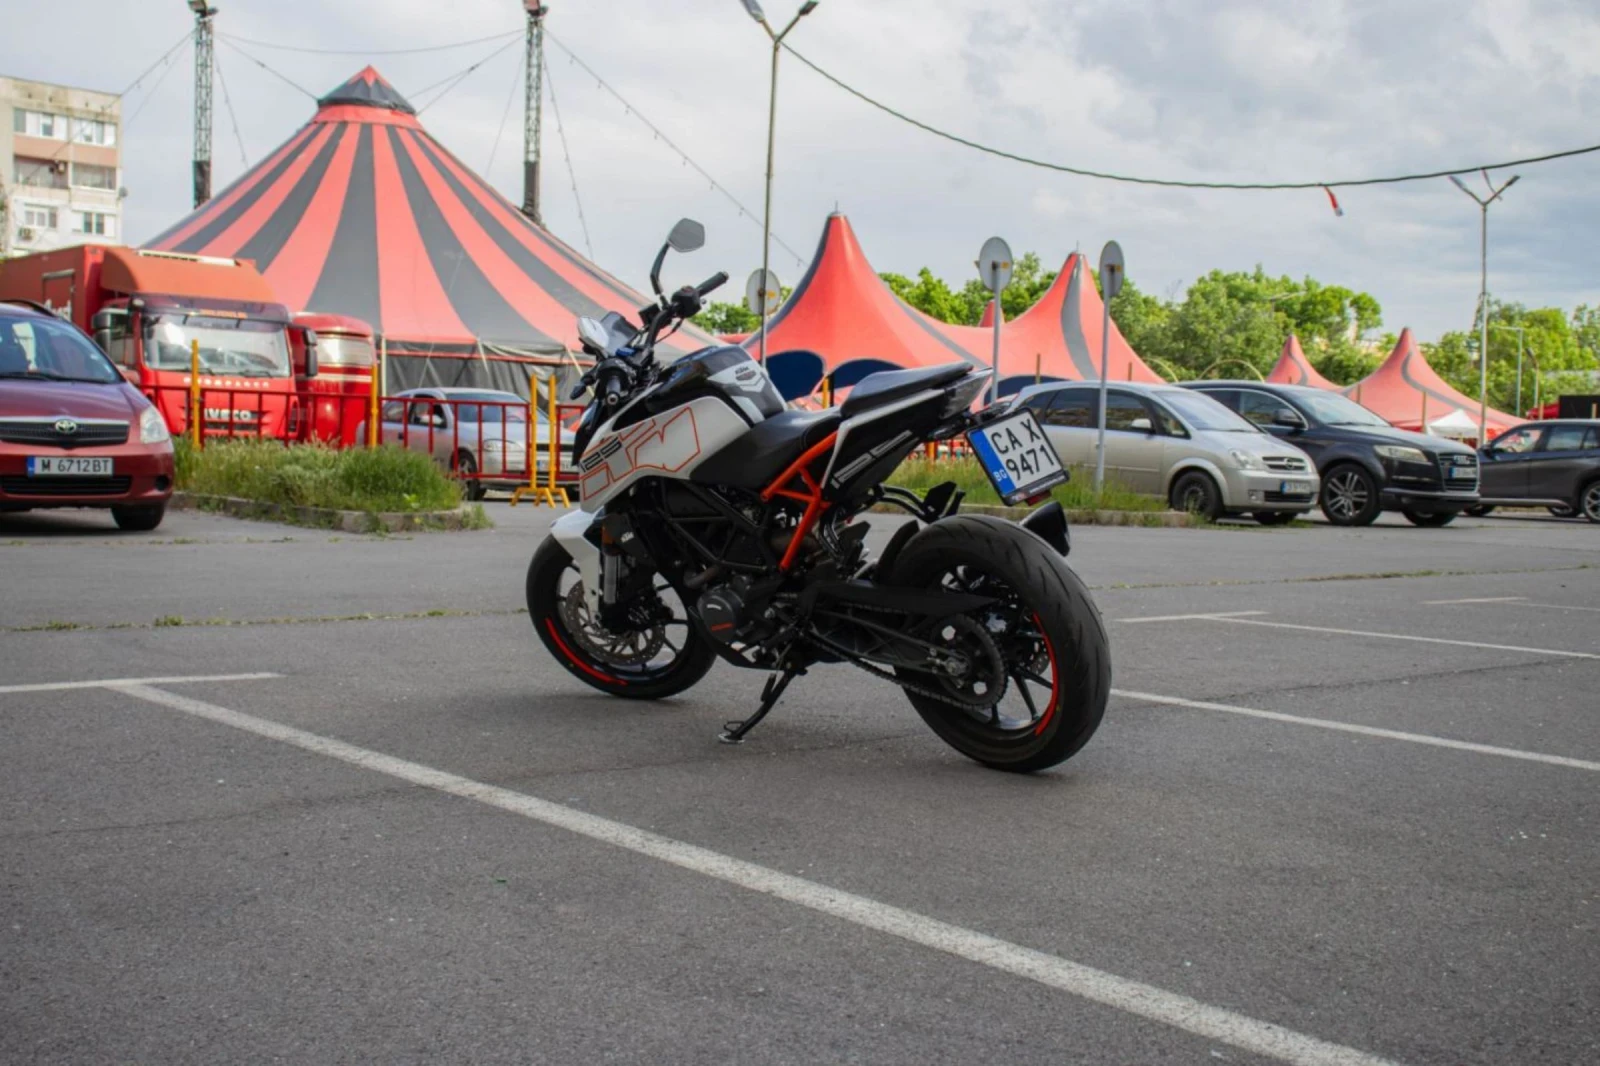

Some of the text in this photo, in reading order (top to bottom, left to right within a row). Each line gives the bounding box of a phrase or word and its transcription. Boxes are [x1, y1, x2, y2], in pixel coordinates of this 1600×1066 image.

[204, 408, 252, 420] IVECO
[991, 418, 1041, 454] CA X
[41, 459, 51, 472] M
[830, 429, 913, 490] 125
[1006, 444, 1055, 481] 9471
[993, 469, 1008, 482] BG
